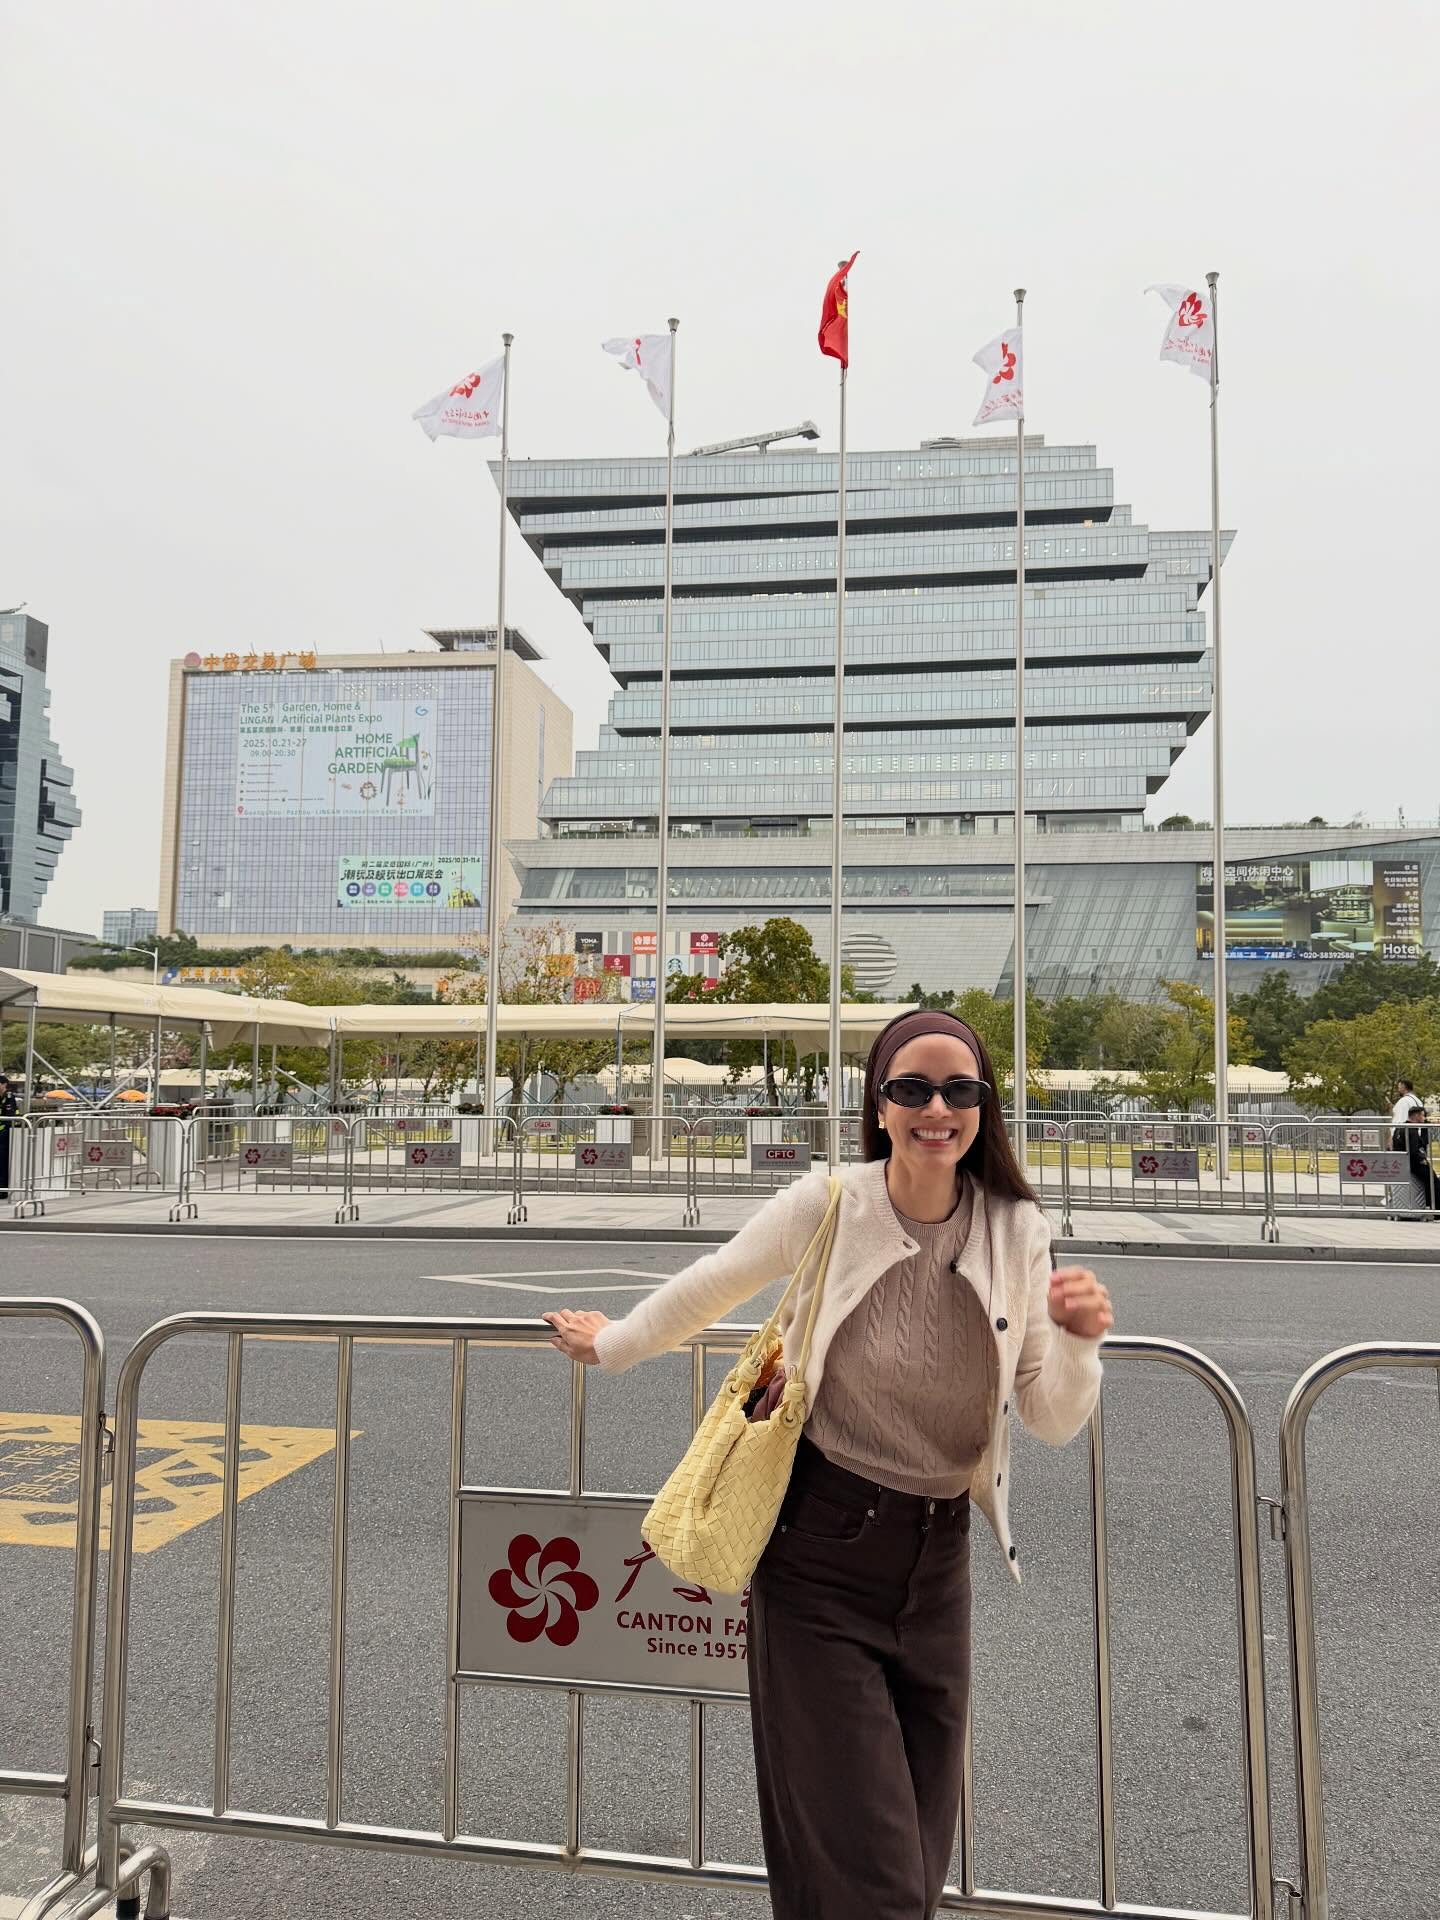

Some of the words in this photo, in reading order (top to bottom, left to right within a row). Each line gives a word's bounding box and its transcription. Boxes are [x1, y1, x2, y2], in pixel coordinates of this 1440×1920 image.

[241, 703, 260, 713] The
[282, 702, 320, 713] Garden,
[323, 702, 352, 711] Home
[354, 701, 361, 710] &
[240, 716, 274, 725] LINGAN
[282, 713, 323, 724] Artificial
[325, 712, 355, 723] Plants
[358, 713, 383, 724] Expo
[355, 733, 393, 744] HOME
[335, 746, 408, 759] ARTIFICIAL
[328, 762, 384, 775] GARDEN
[1201, 866, 1294, 877] 有空间休闲中心
[1383, 943, 1420, 954] Hotel
[767, 1150, 794, 1158] CFTC
[616, 1611, 712, 1635] CANTON
[724, 1618, 747, 1637] FA
[647, 1637, 698, 1656] Since
[703, 1641, 748, 1660] 1957
